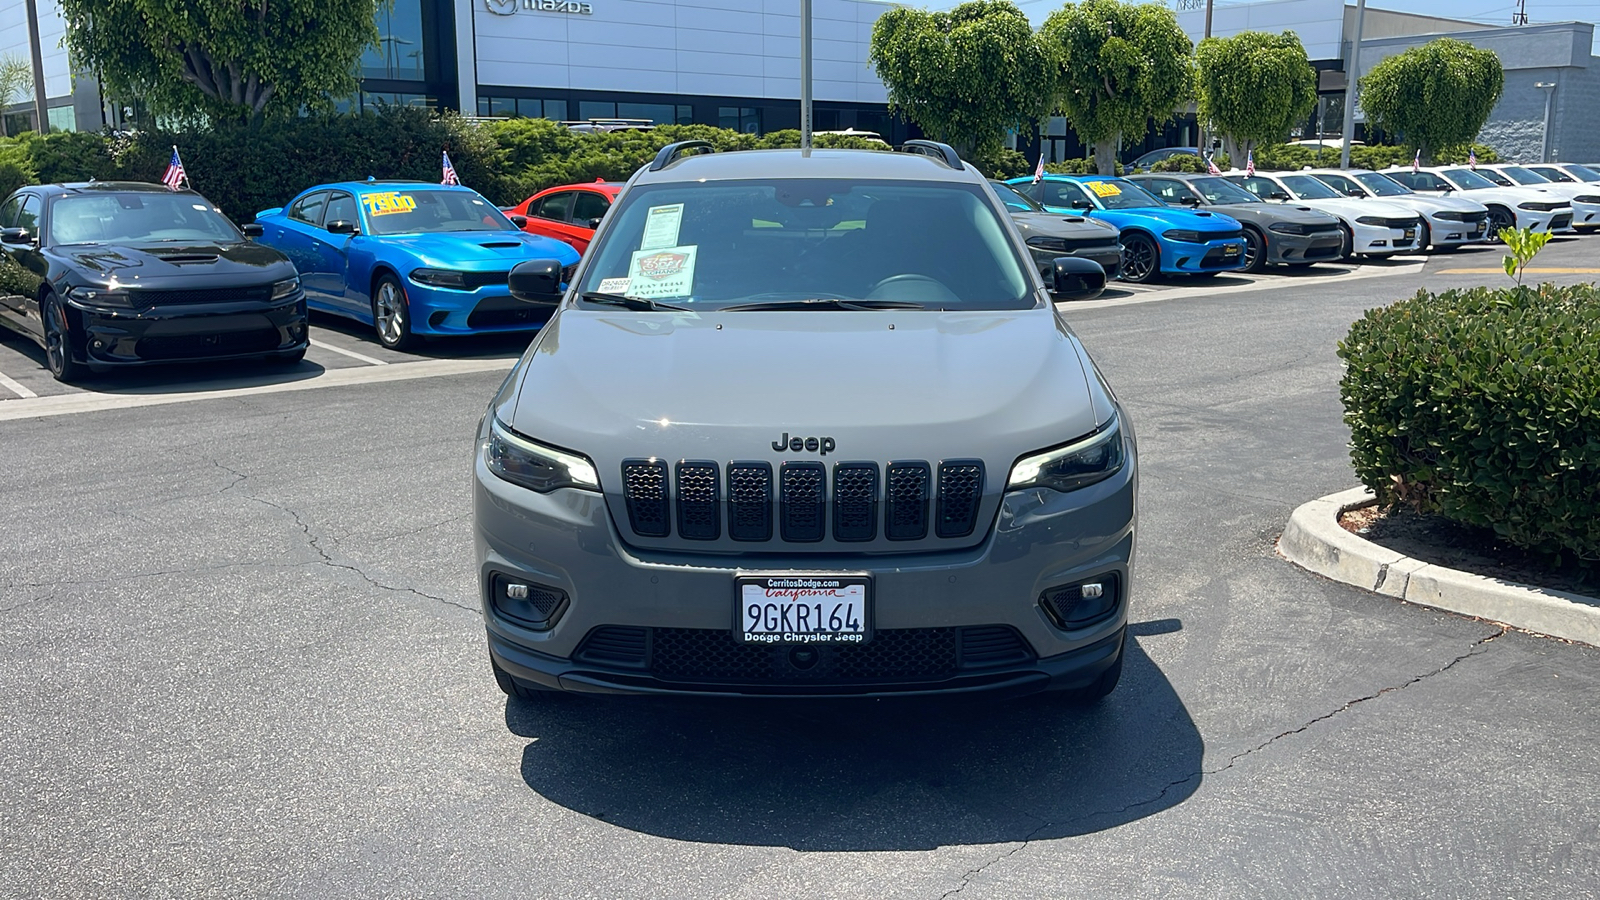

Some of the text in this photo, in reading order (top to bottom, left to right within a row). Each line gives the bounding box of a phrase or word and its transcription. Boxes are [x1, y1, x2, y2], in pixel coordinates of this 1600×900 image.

[522, 0, 593, 15] mazda
[363, 195, 418, 213] 7900
[771, 432, 836, 456] Jeep
[767, 579, 840, 588] CerritosDodge.com
[765, 588, 845, 602] California
[747, 603, 859, 632] 9GKR164
[744, 632, 863, 643] Dodge Chrysler Jeep
